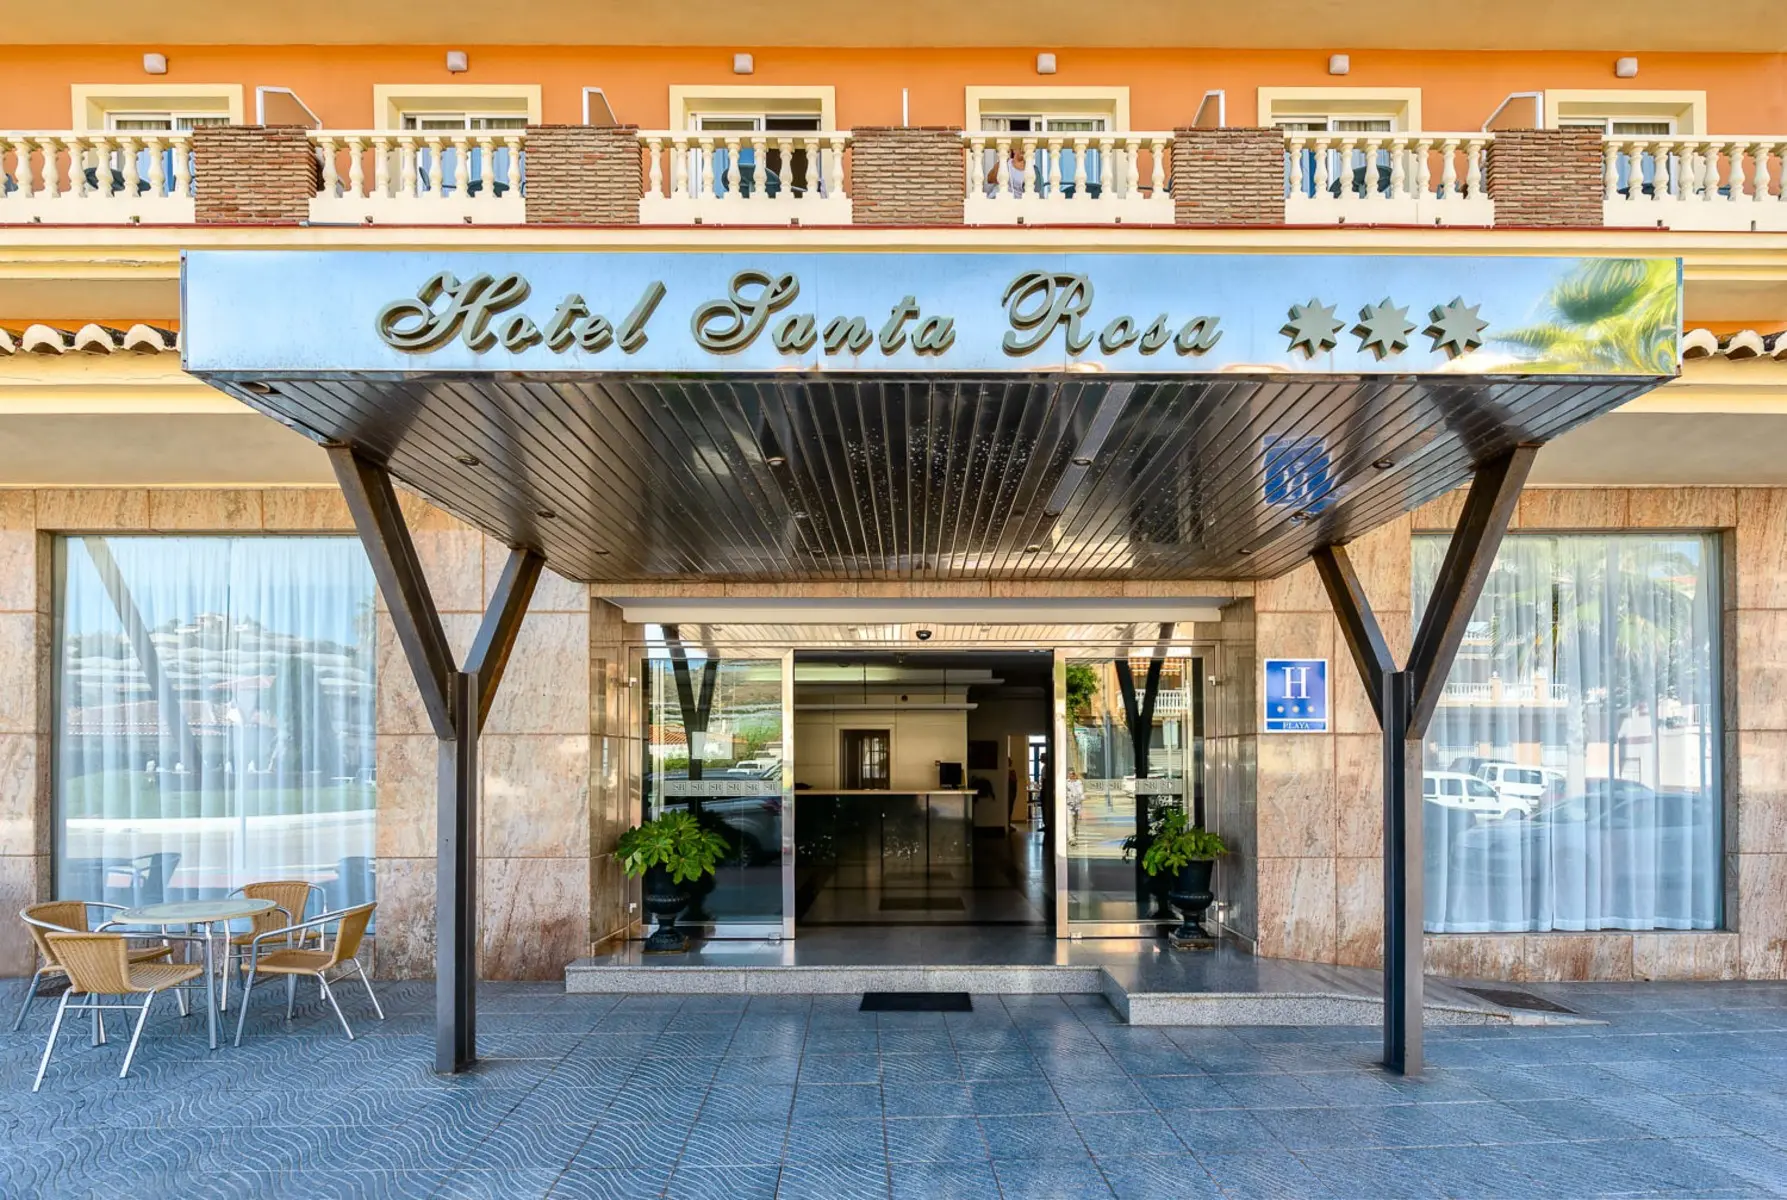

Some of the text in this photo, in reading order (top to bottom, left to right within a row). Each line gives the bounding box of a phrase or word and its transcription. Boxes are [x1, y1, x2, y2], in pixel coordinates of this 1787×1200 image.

[375, 268, 1223, 357] Hotel Santa Rosa
[1281, 666, 1311, 699] H
[1282, 721, 1310, 730] PLAYA
